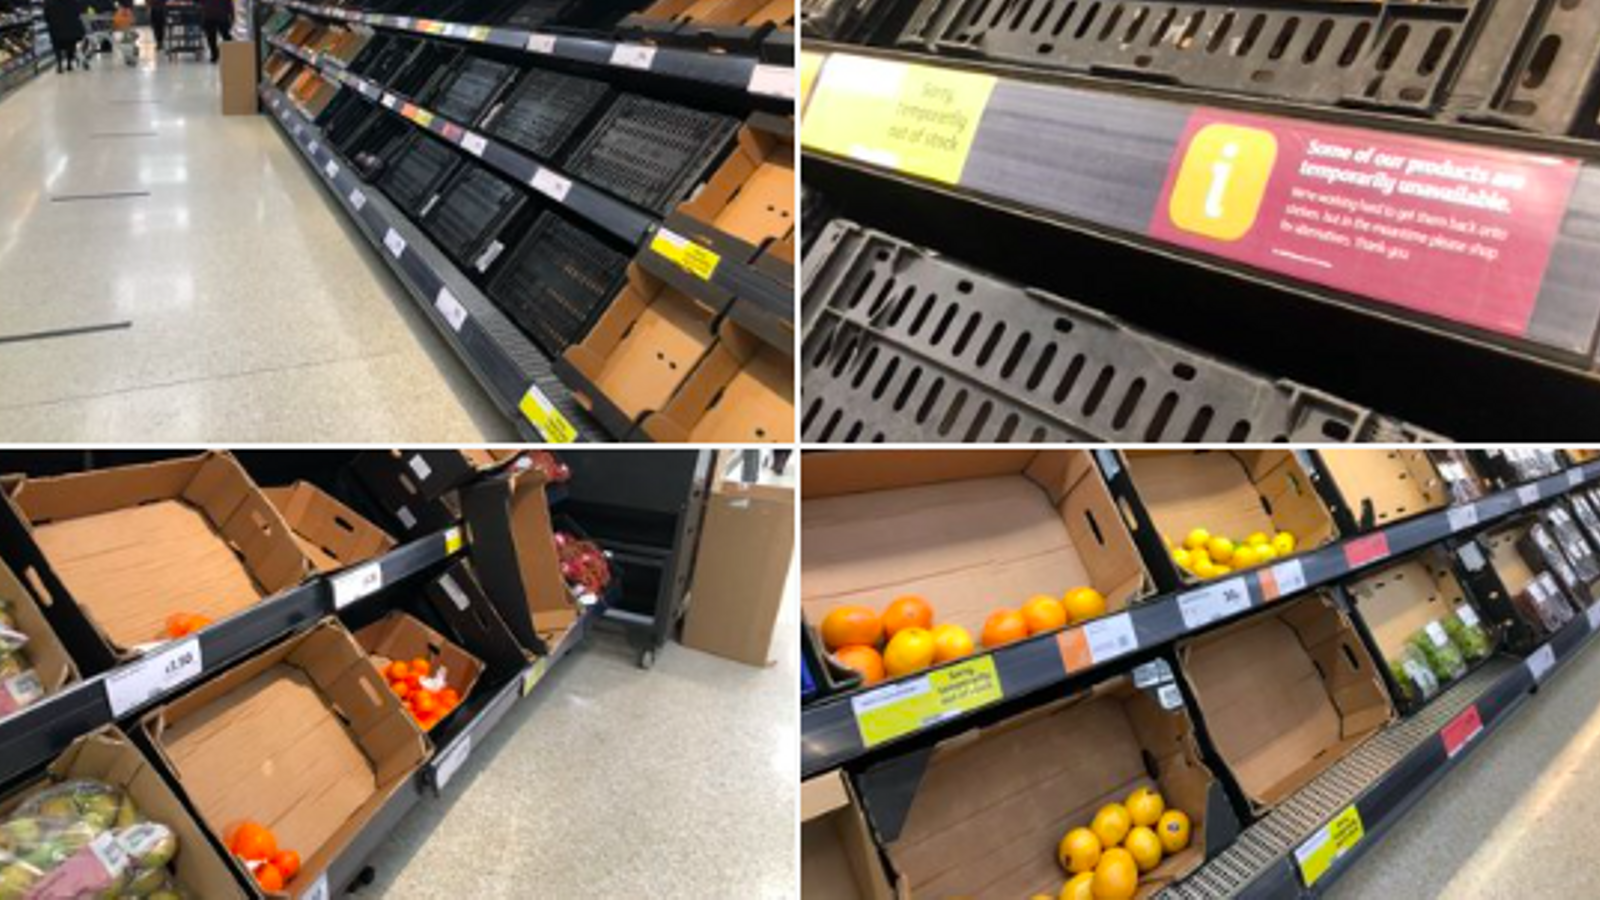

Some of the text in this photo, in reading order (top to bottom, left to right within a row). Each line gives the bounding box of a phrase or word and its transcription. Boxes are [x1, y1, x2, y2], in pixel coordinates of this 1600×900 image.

[922, 81, 954, 106] Sorry
[887, 126, 959, 152] out of stock
[1299, 159, 1512, 215] temporarily unavailable.
[1306, 139, 1526, 191] Some of our products are
[1318, 194, 1359, 213] working
[1359, 198, 1384, 216] hard
[1384, 204, 1396, 217] to
[1396, 207, 1416, 223] get
[1416, 208, 1448, 227] them
[1448, 215, 1477, 233] back
[1478, 226, 1509, 242] onto
[1321, 209, 1341, 225] but
[1341, 213, 1353, 227] in
[1354, 217, 1371, 232] the
[1372, 222, 1428, 244] meantime
[1428, 233, 1467, 254] please
[1467, 242, 1500, 262] shop
[1354, 235, 1386, 254] Thank
